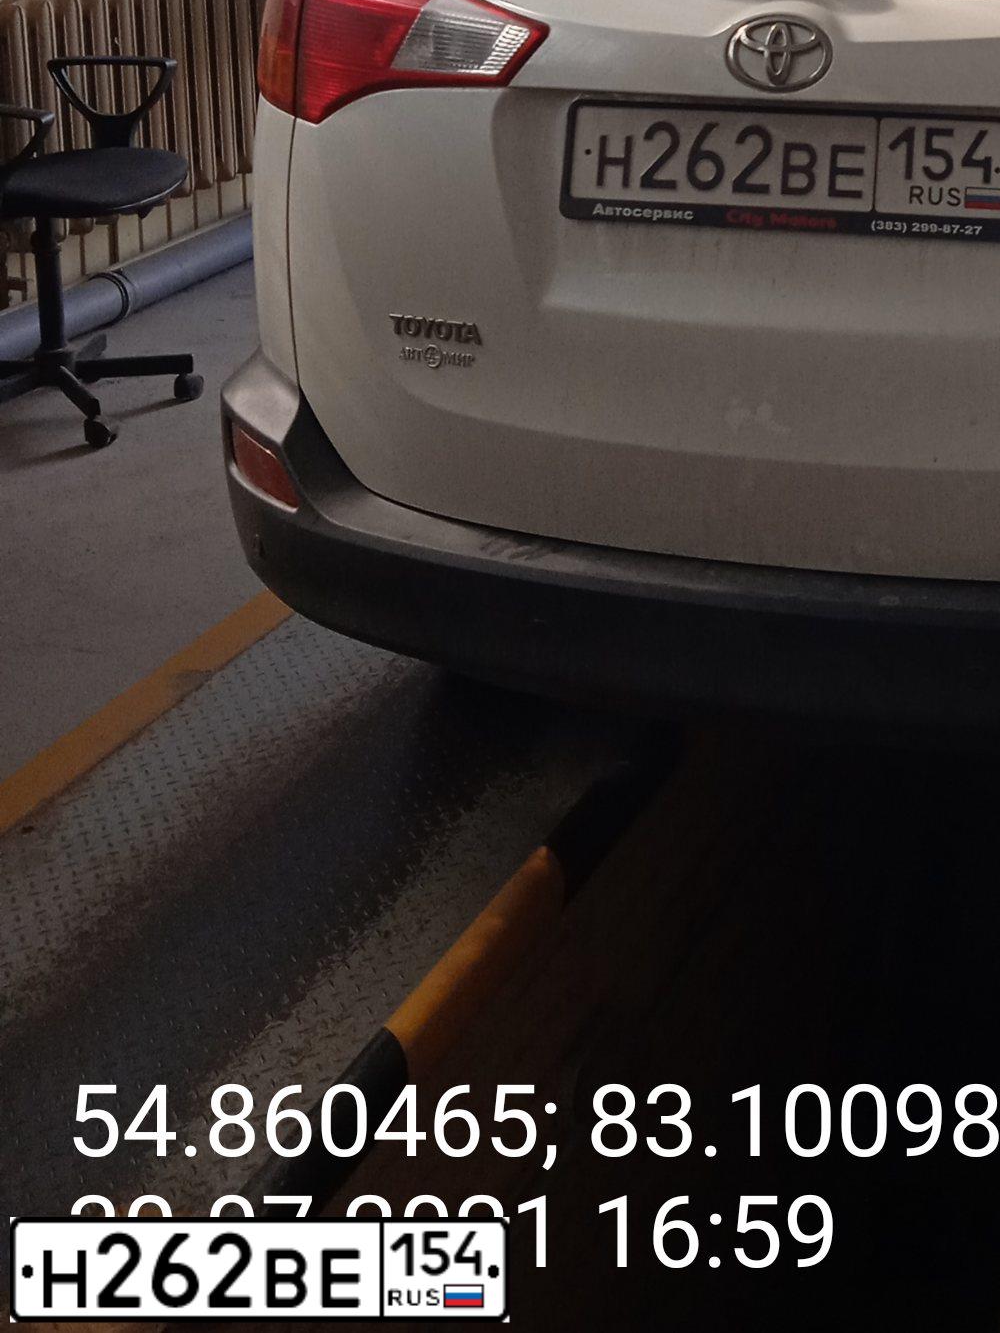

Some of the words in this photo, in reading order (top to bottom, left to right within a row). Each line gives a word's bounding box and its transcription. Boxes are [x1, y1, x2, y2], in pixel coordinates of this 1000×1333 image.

[888, 127, 993, 185] 154
[909, 185, 961, 207] RUS
[592, 203, 694, 221] Автосервис
[871, 220, 908, 233] (383)
[912, 222, 983, 235] 299-87-27
[388, 313, 482, 346] TOYOTA
